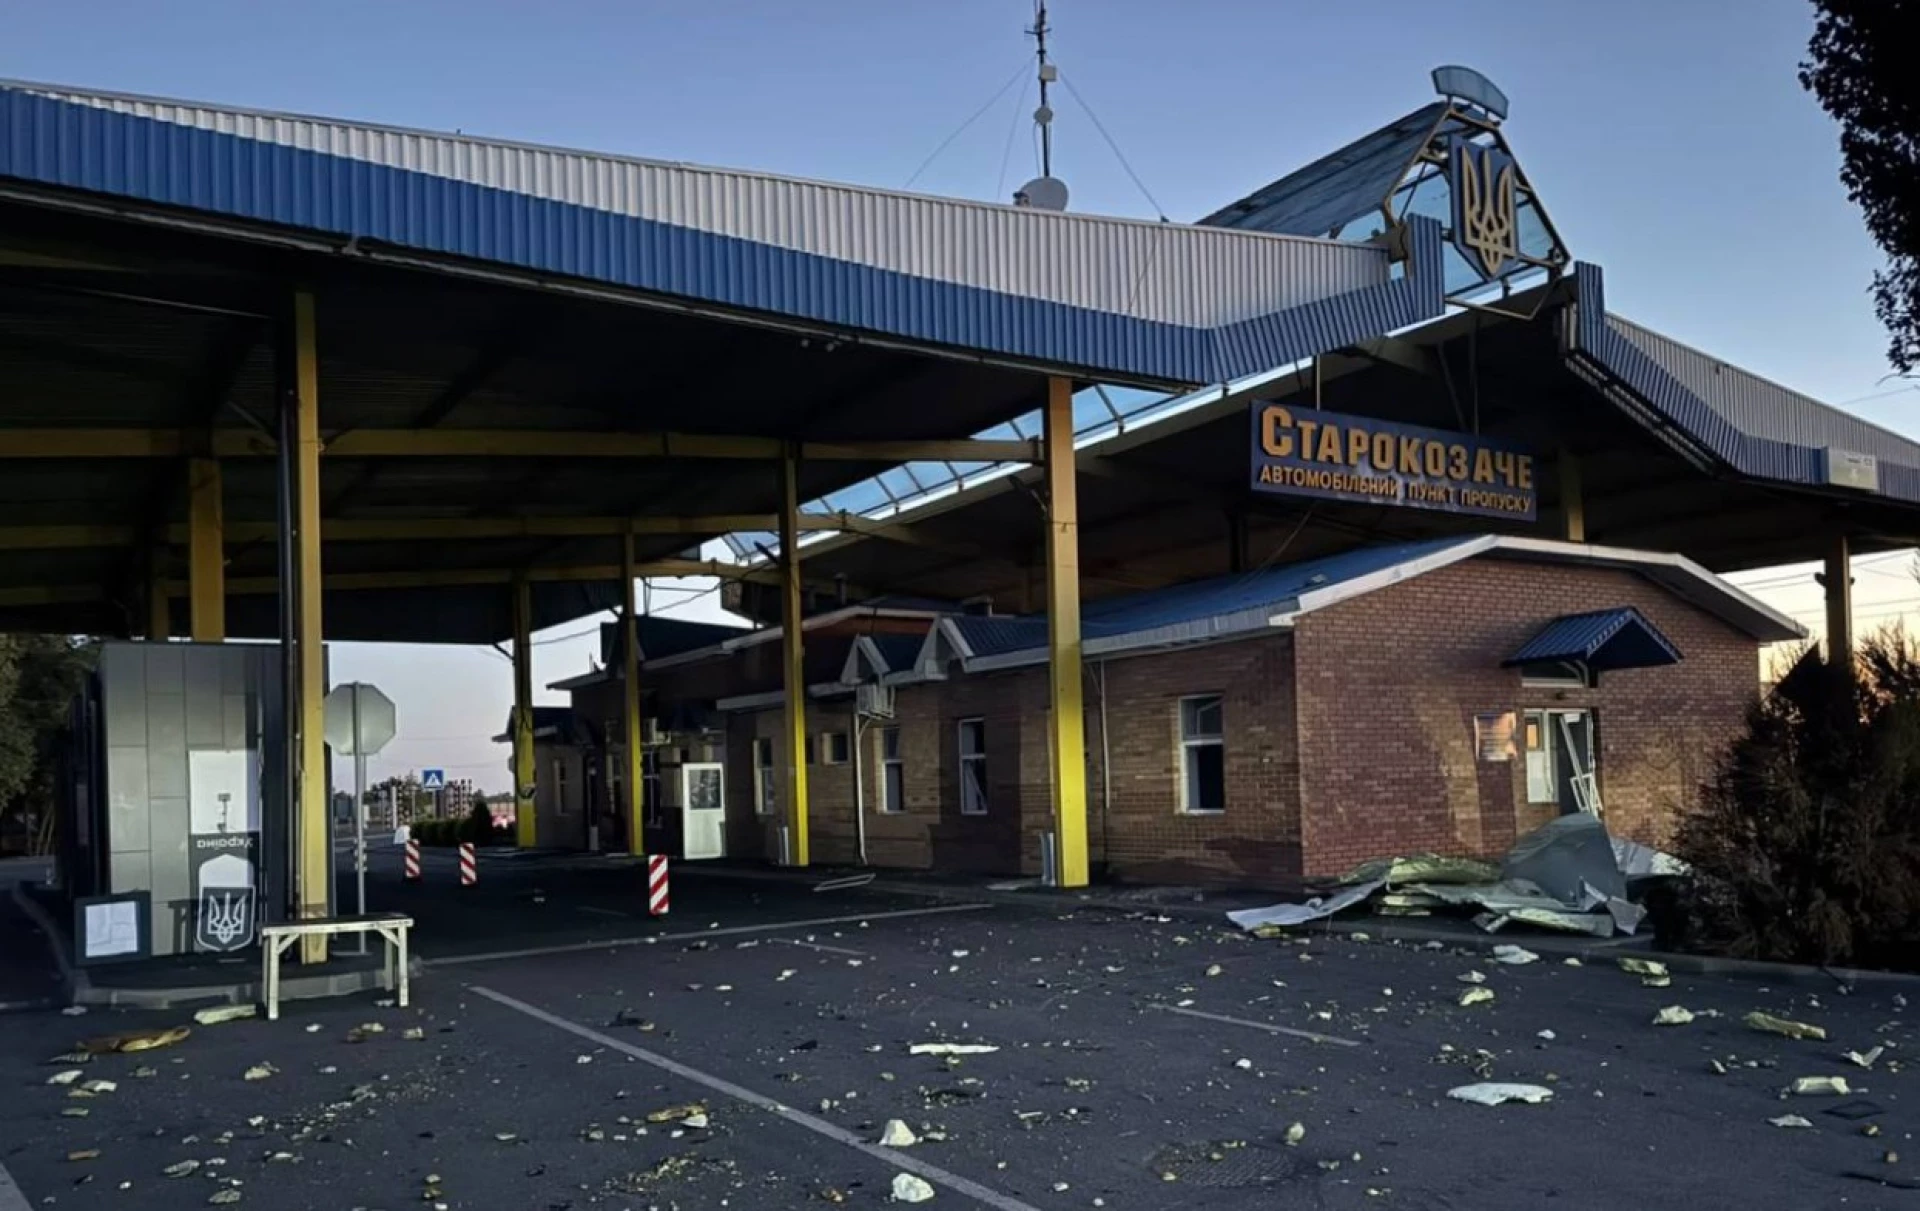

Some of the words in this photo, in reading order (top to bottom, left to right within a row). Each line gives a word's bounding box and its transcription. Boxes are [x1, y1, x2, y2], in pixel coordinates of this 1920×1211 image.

[1261, 406, 1533, 488] СТАРОКОЗАЧЕ
[1408, 481, 1455, 504] ПУНКТ
[1461, 488, 1532, 514] ПРОПУСКУ
